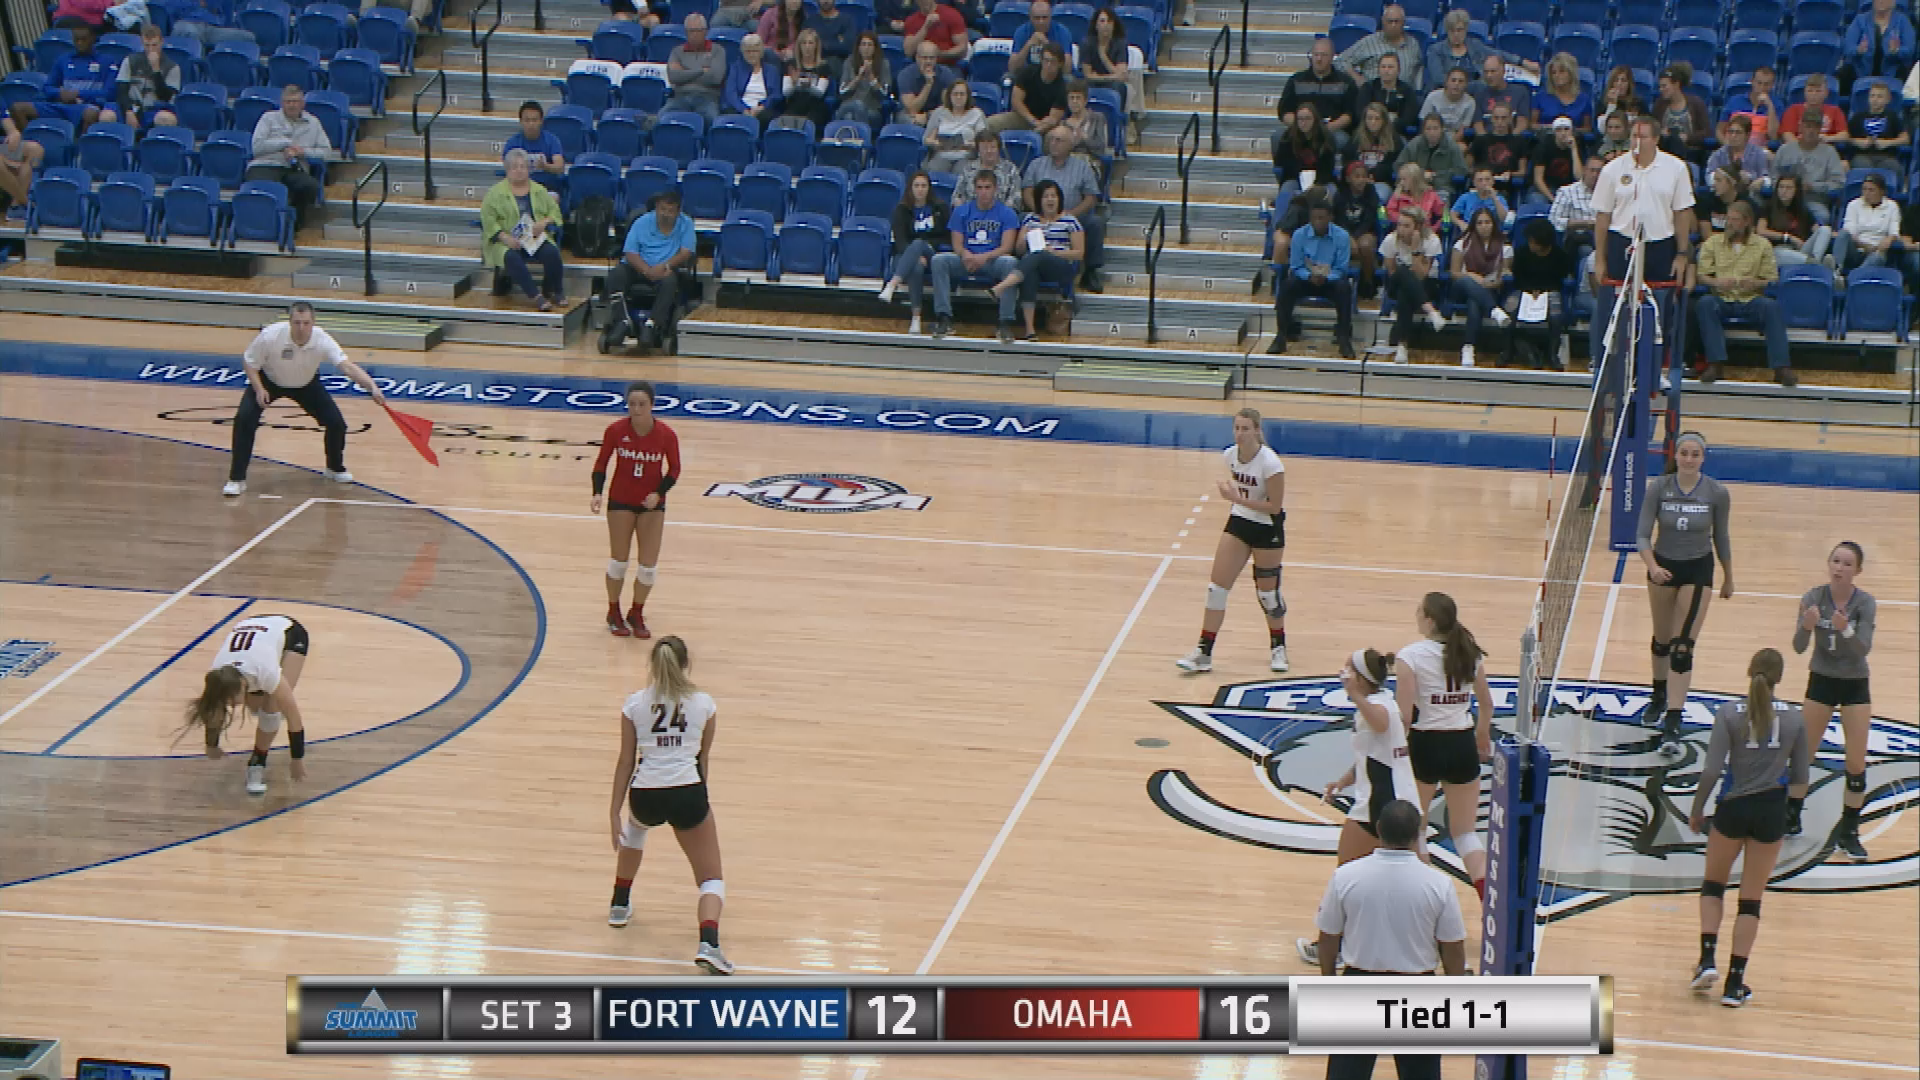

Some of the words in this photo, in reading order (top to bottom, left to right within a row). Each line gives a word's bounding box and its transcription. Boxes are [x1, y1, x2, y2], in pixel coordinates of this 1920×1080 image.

[617, 447, 662, 462] OMAHA
[633, 463, 644, 477] 8
[1231, 470, 1258, 487] MAHA
[650, 703, 688, 733] 24
[656, 735, 682, 747] ROTH
[1483, 800, 1505, 976] MASTOD
